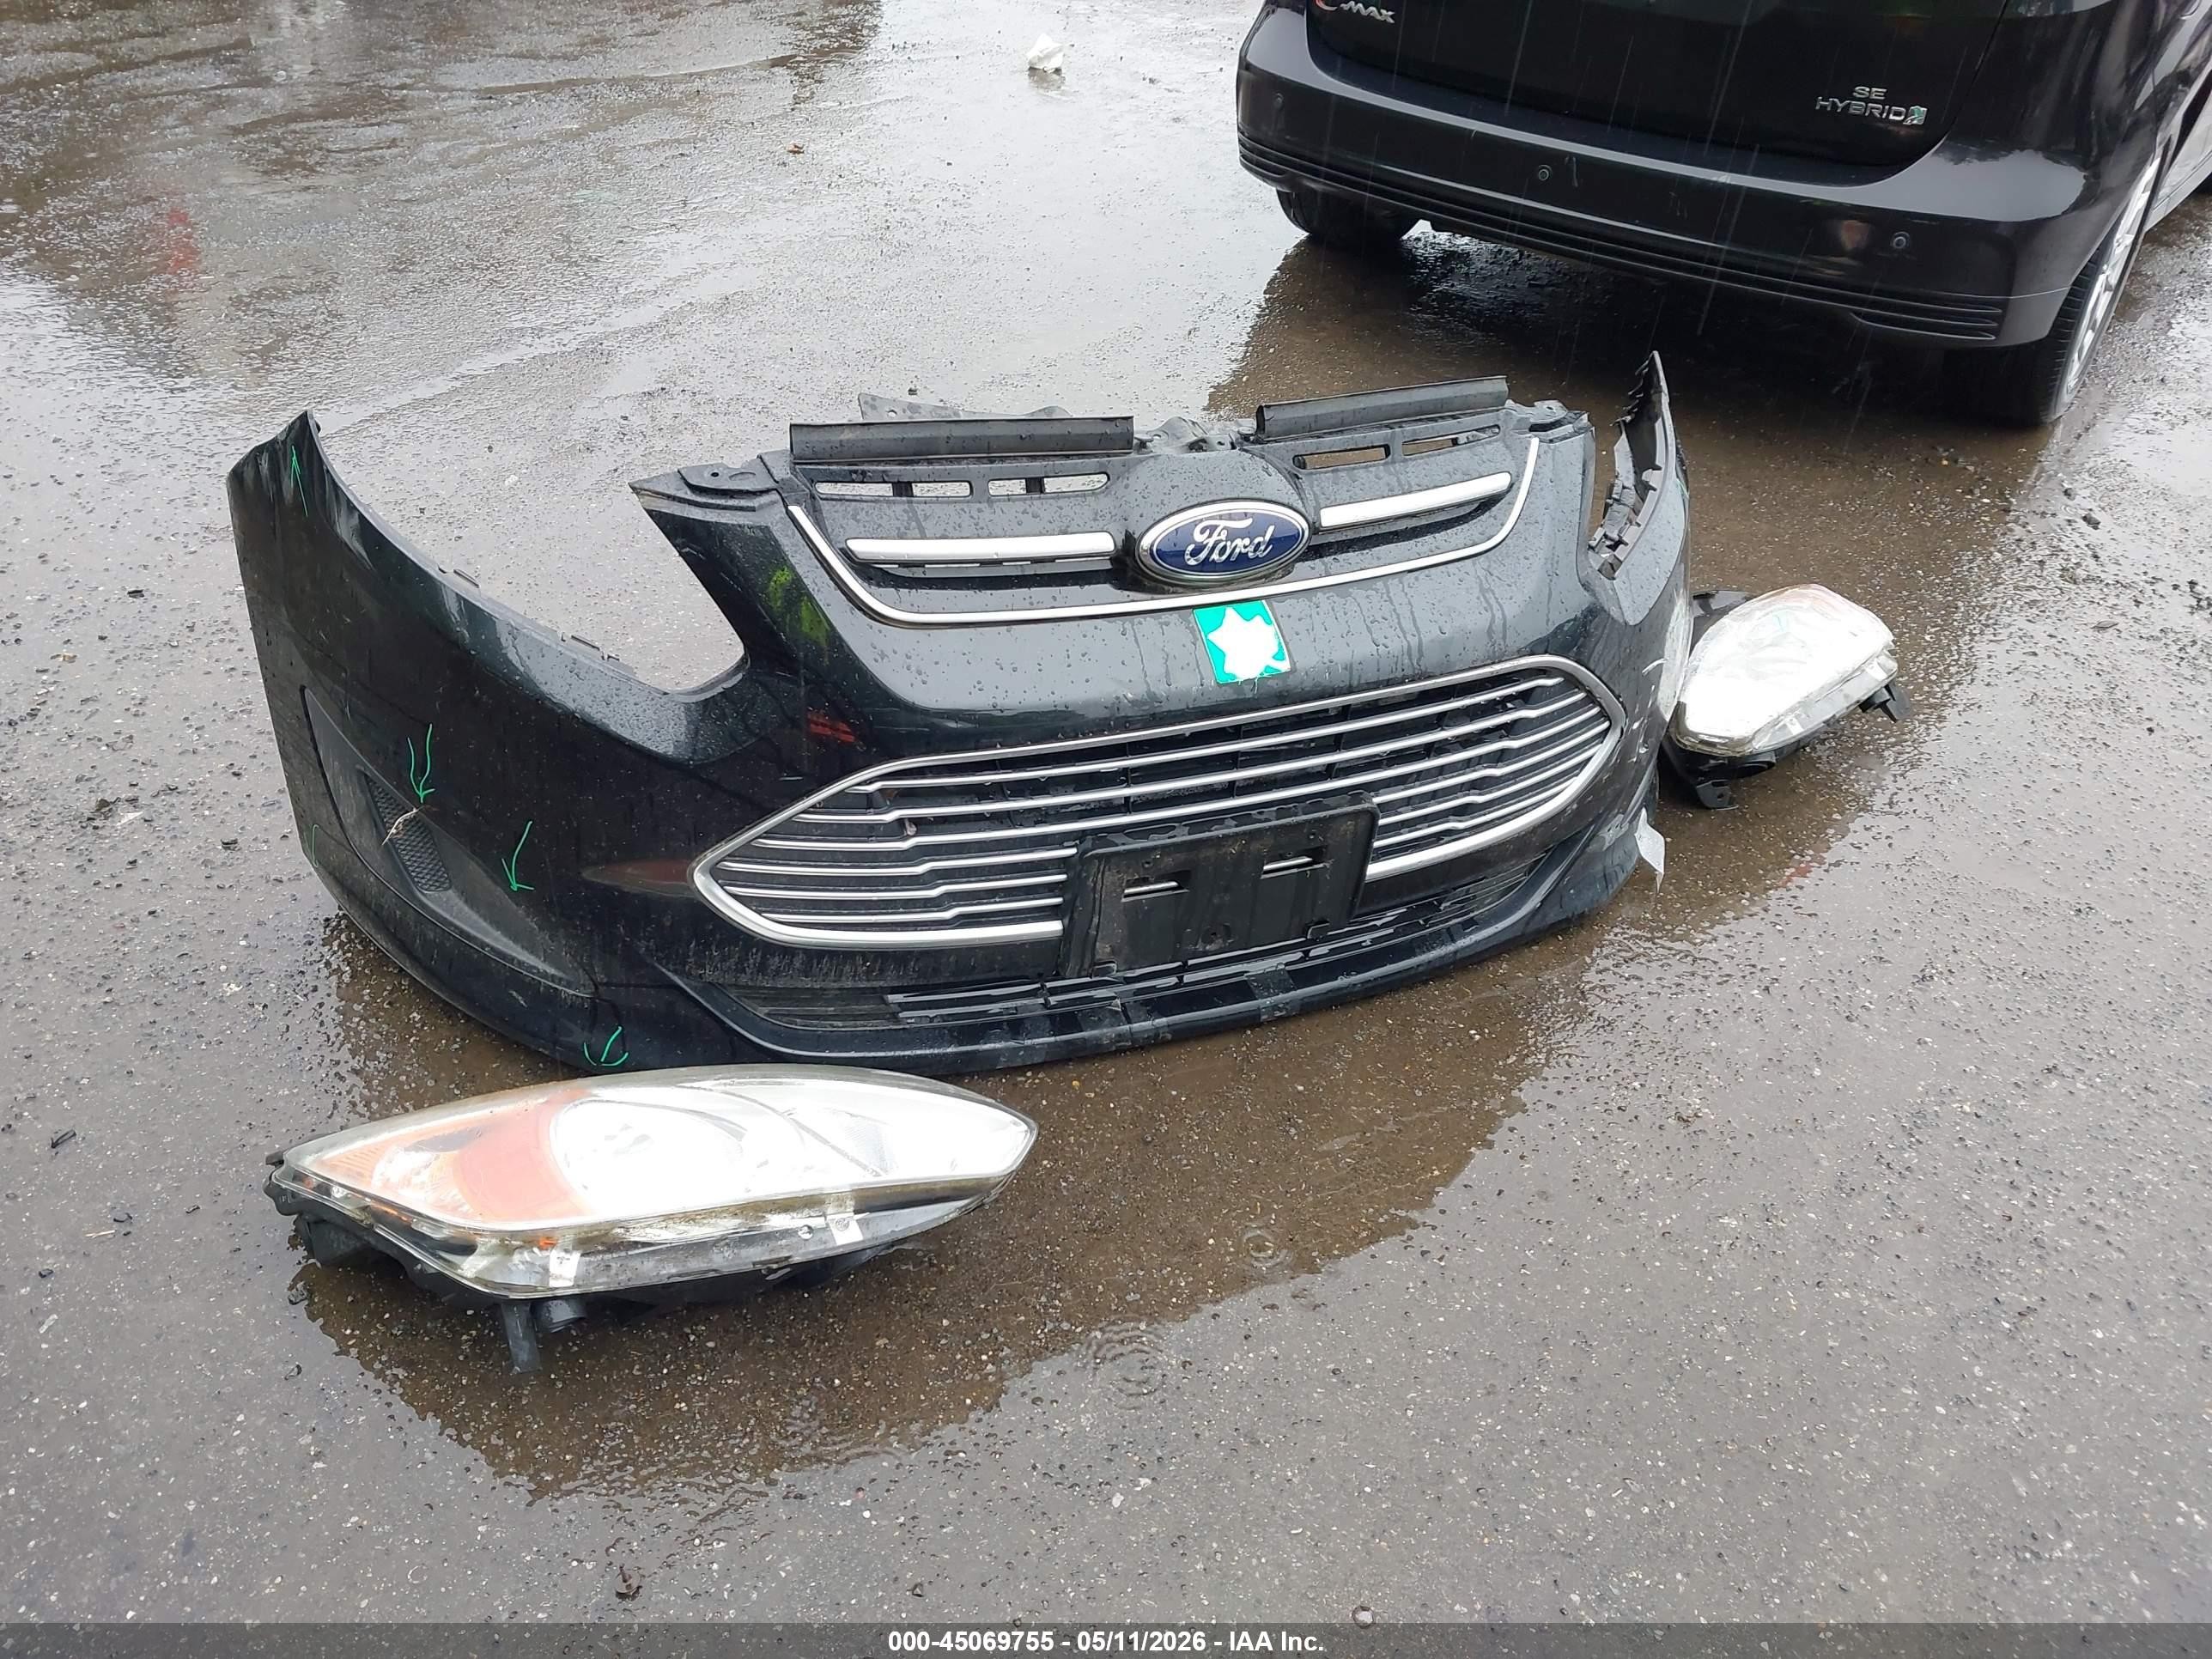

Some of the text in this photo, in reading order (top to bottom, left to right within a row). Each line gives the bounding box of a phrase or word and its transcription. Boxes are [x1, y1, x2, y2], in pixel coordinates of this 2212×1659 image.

[1852, 86, 1887, 100] SE
[1814, 96, 1906, 121] HYBRID
[1184, 517, 1276, 566] Ford
